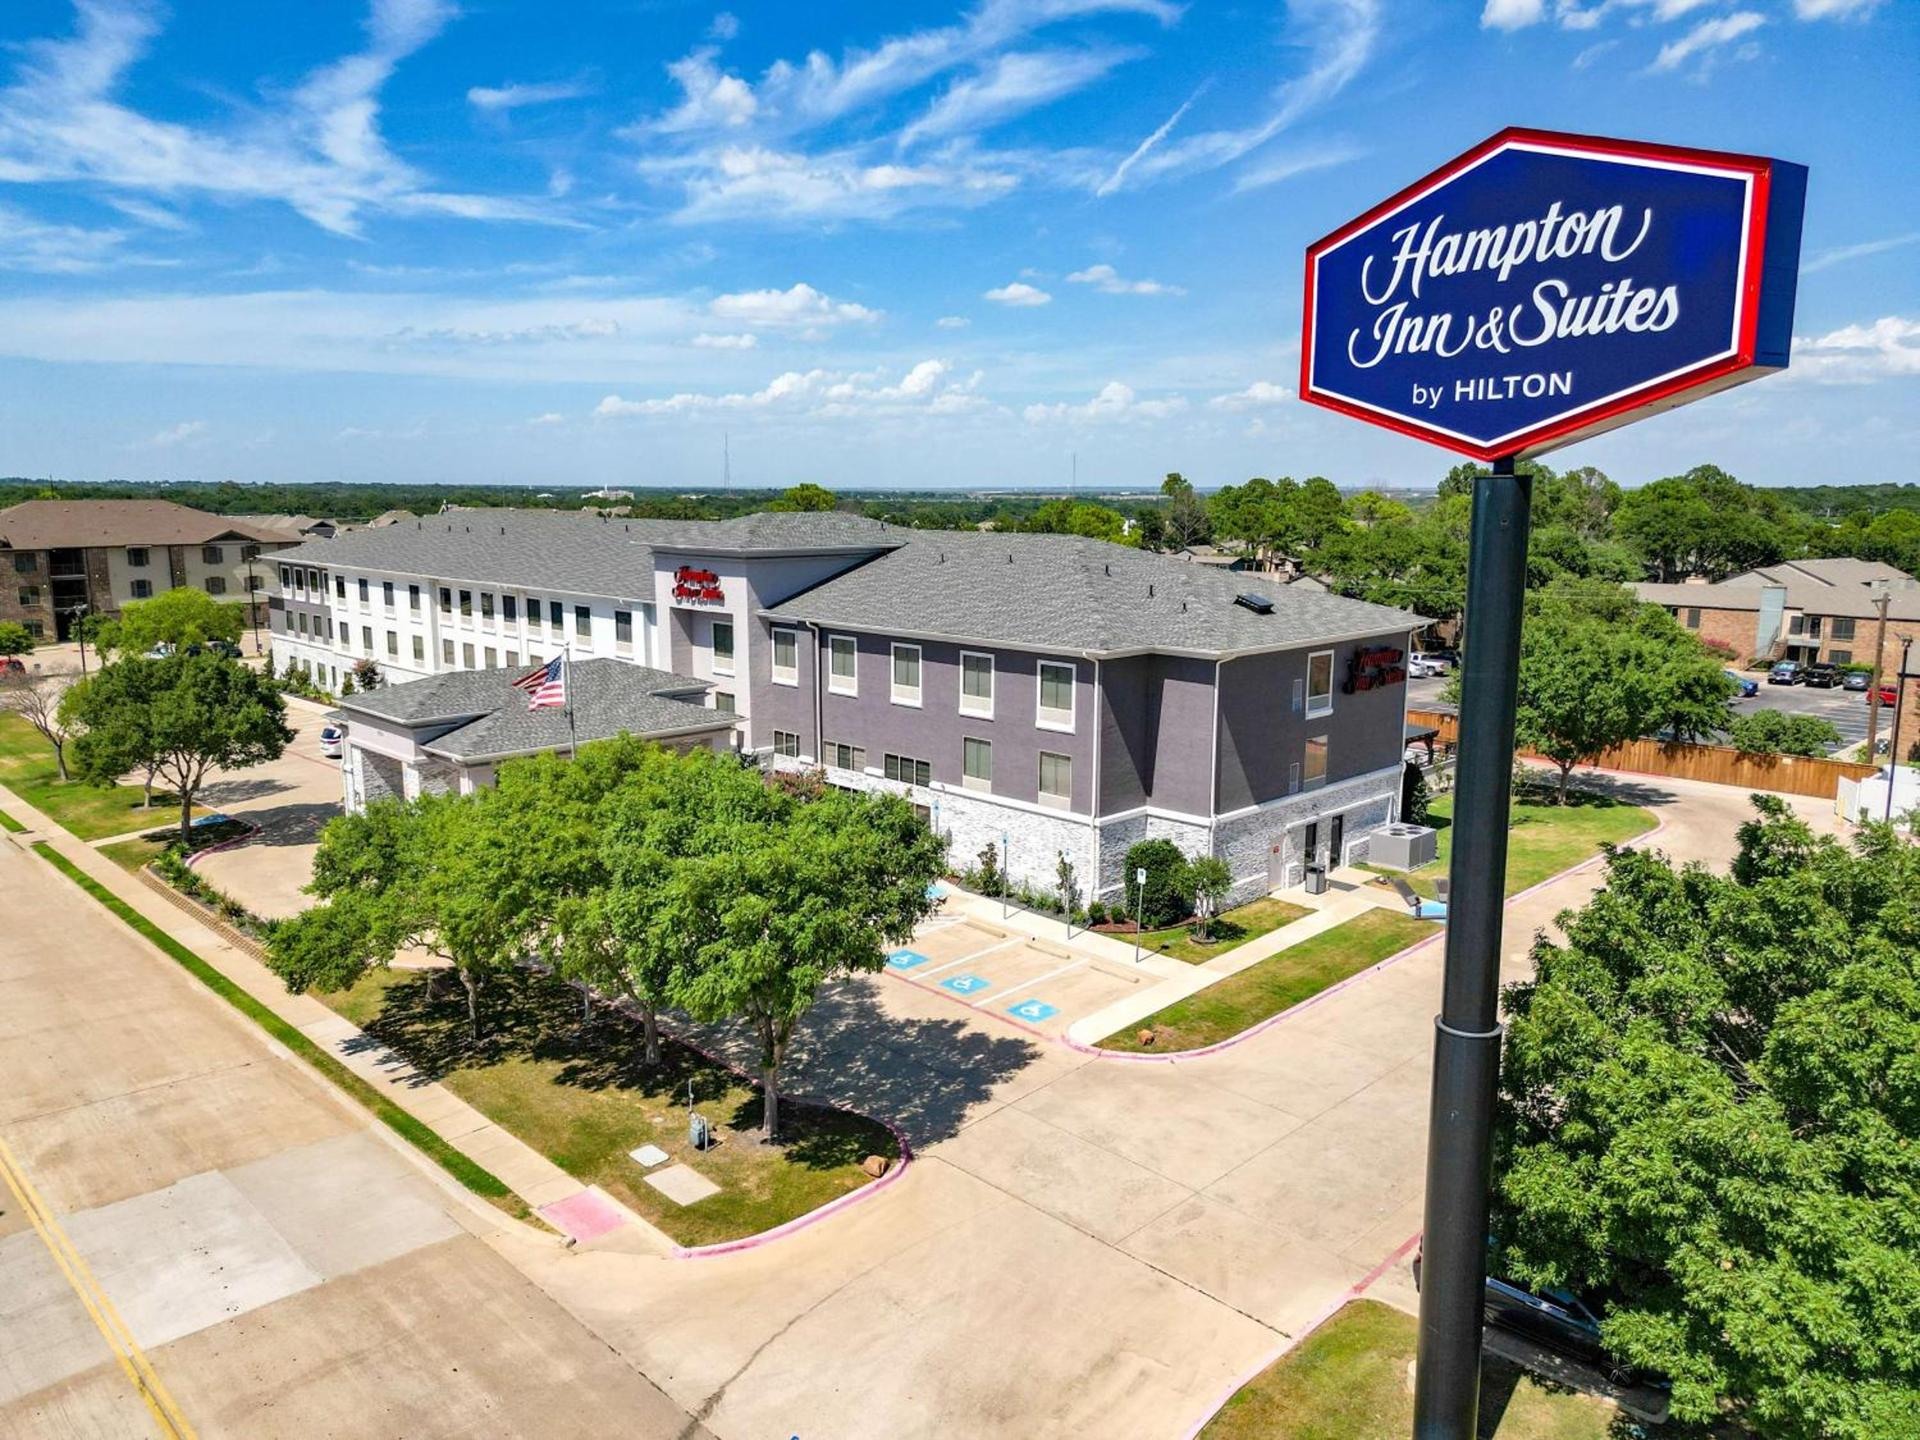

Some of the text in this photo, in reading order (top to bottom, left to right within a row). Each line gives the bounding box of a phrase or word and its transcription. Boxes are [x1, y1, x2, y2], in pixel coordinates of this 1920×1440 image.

[1361, 201, 1652, 305] Hampton
[1348, 278, 1679, 368] Inn & Suites
[1412, 371, 1572, 409] by HILTON
